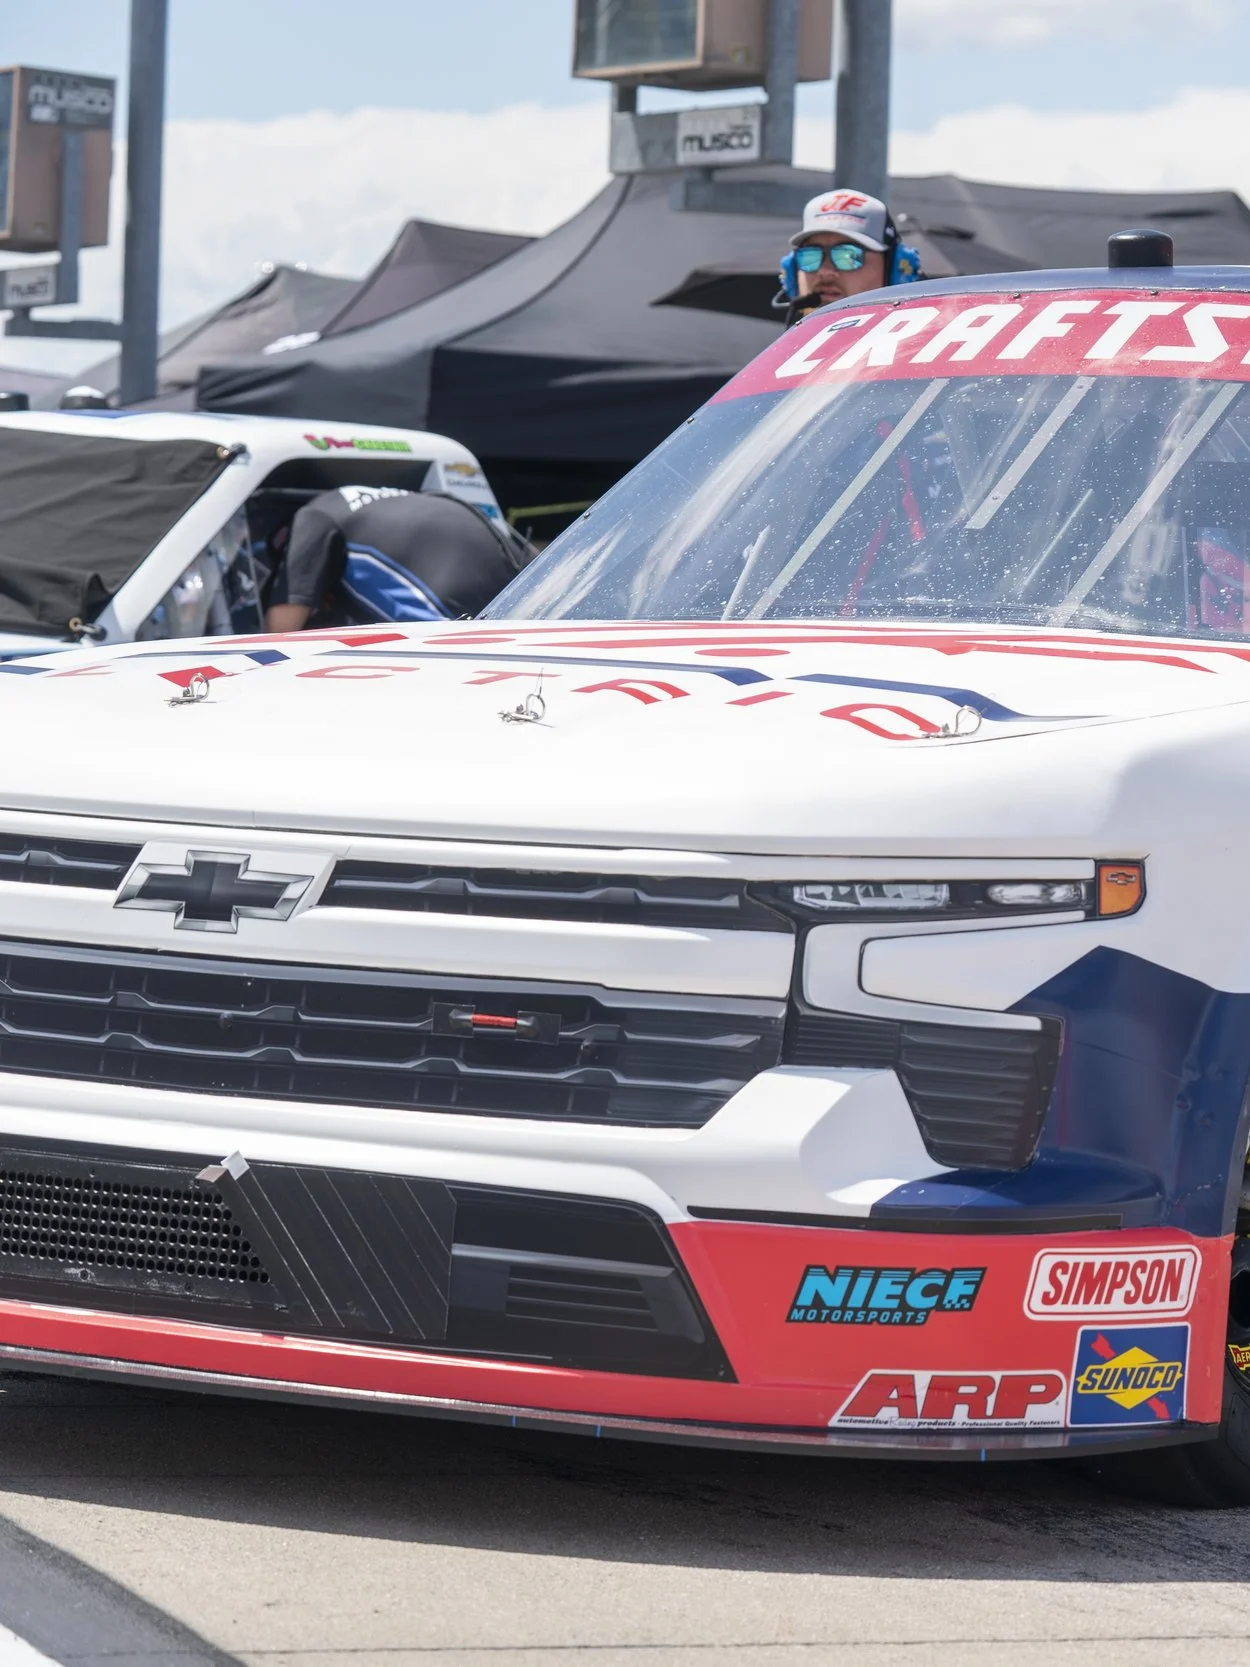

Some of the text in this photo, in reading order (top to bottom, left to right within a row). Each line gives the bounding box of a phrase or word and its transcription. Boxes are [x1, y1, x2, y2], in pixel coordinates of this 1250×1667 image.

[797, 1268, 978, 1309] NIECE
[1042, 1258, 1186, 1305] SIMPSON
[791, 1308, 927, 1324] MOTORSPORTS
[1078, 1362, 1182, 1393] SUNOCO
[840, 1373, 1063, 1419] ARP
[917, 1419, 956, 1427] products
